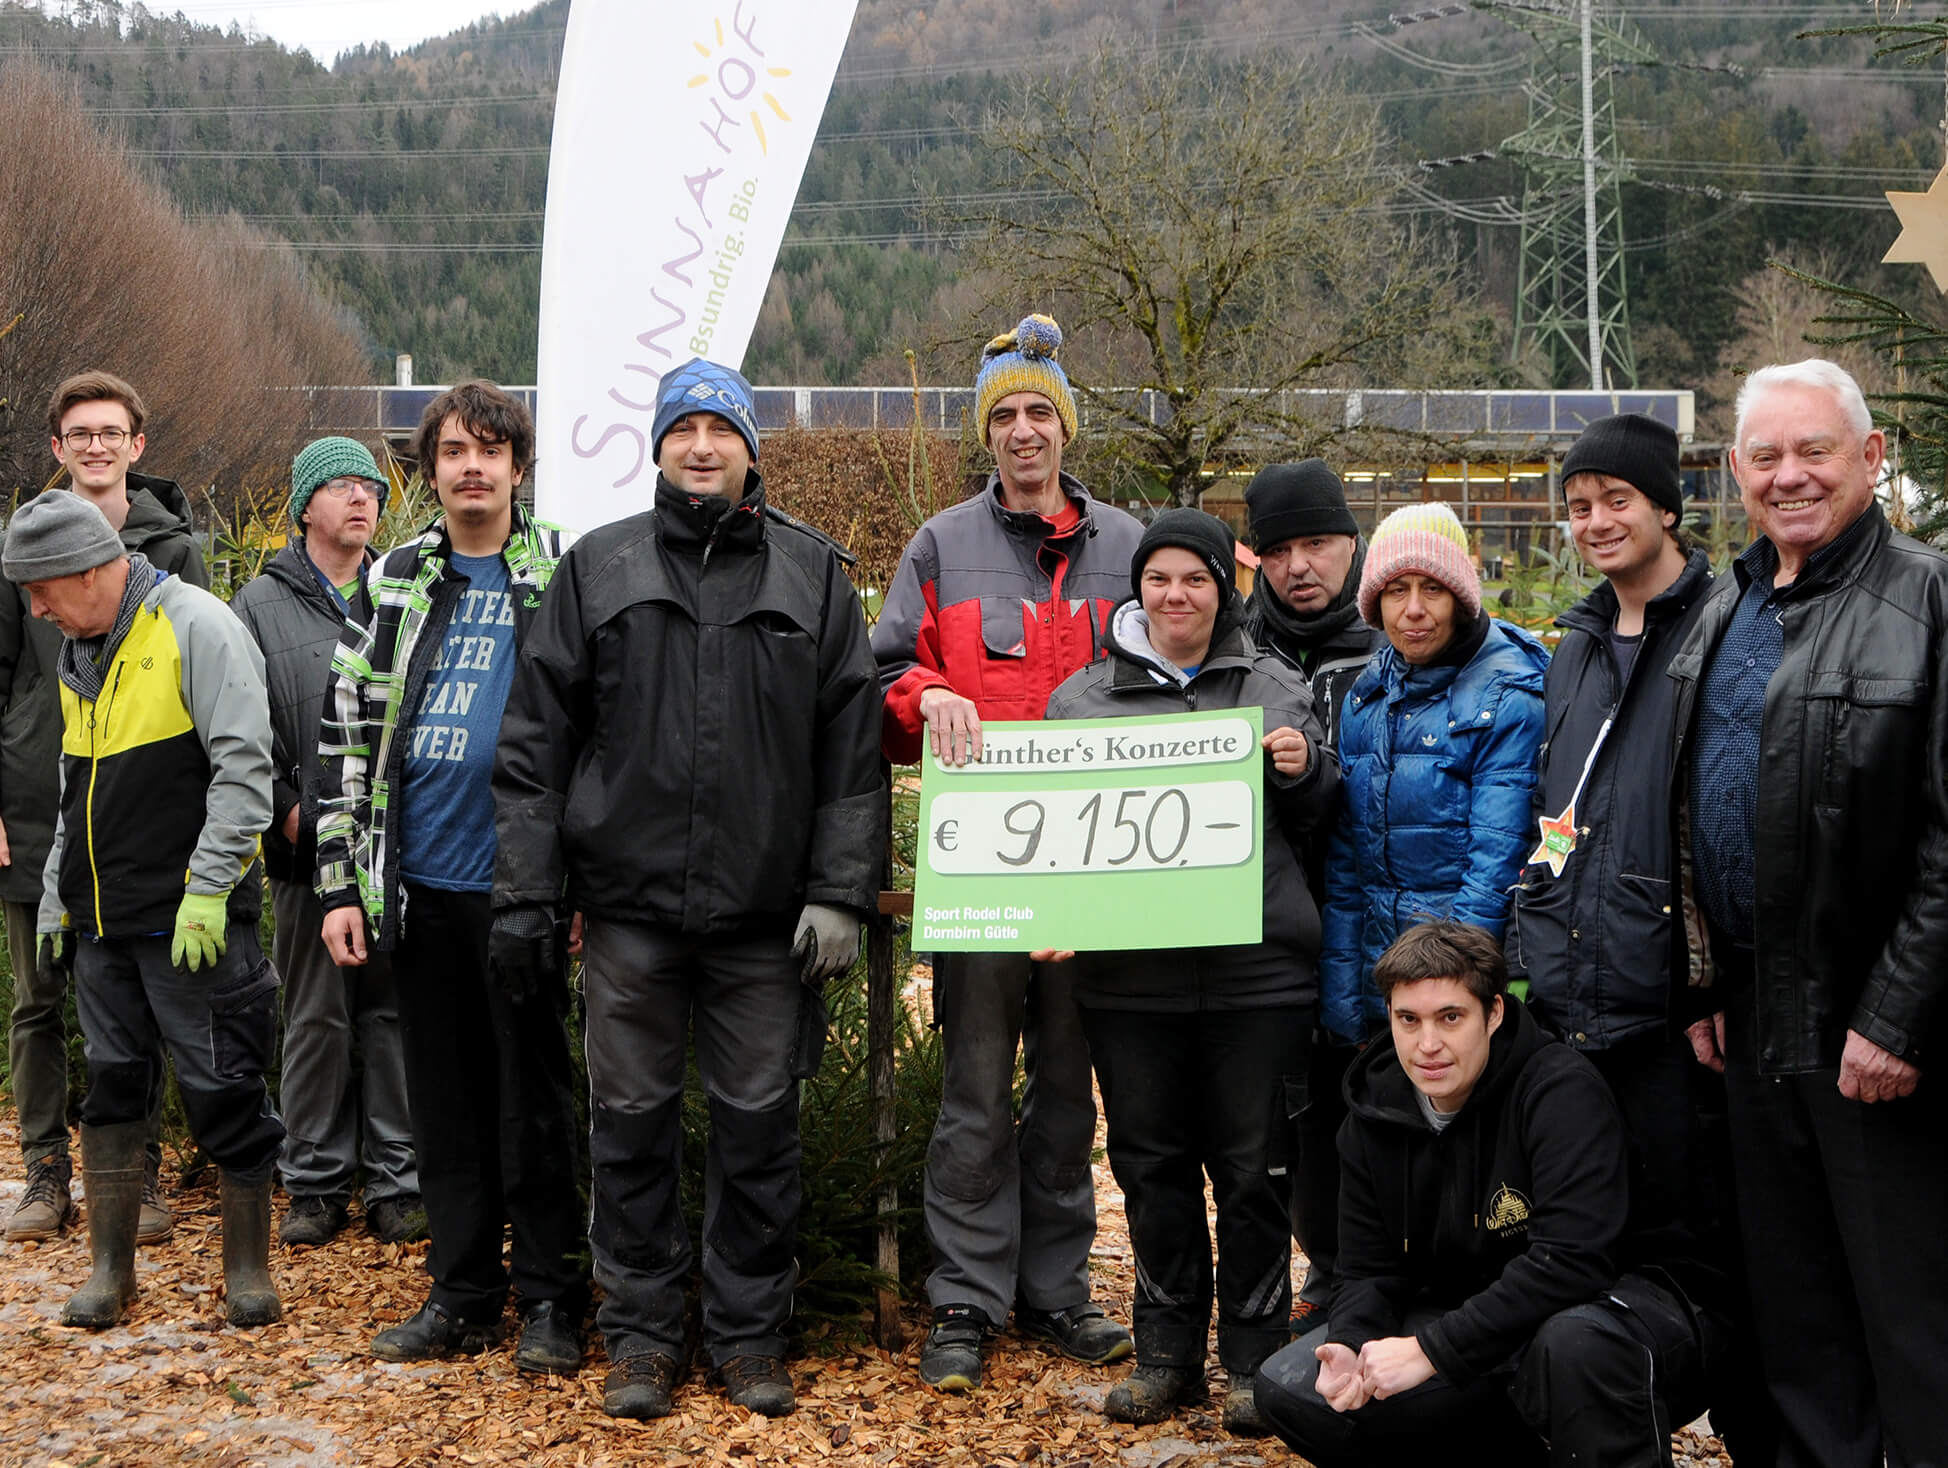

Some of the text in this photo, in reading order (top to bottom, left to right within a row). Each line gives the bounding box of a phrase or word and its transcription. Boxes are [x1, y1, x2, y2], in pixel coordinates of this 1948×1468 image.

[572, 0, 765, 489] SUNNAHOF
[689, 176, 759, 356] Bsundrig. Bio.
[1104, 735, 1238, 762] Konzerte
[933, 819, 959, 852] €
[924, 906, 1034, 922] Sport Rodel Club
[923, 925, 1019, 939] Dornbirn Gütle
